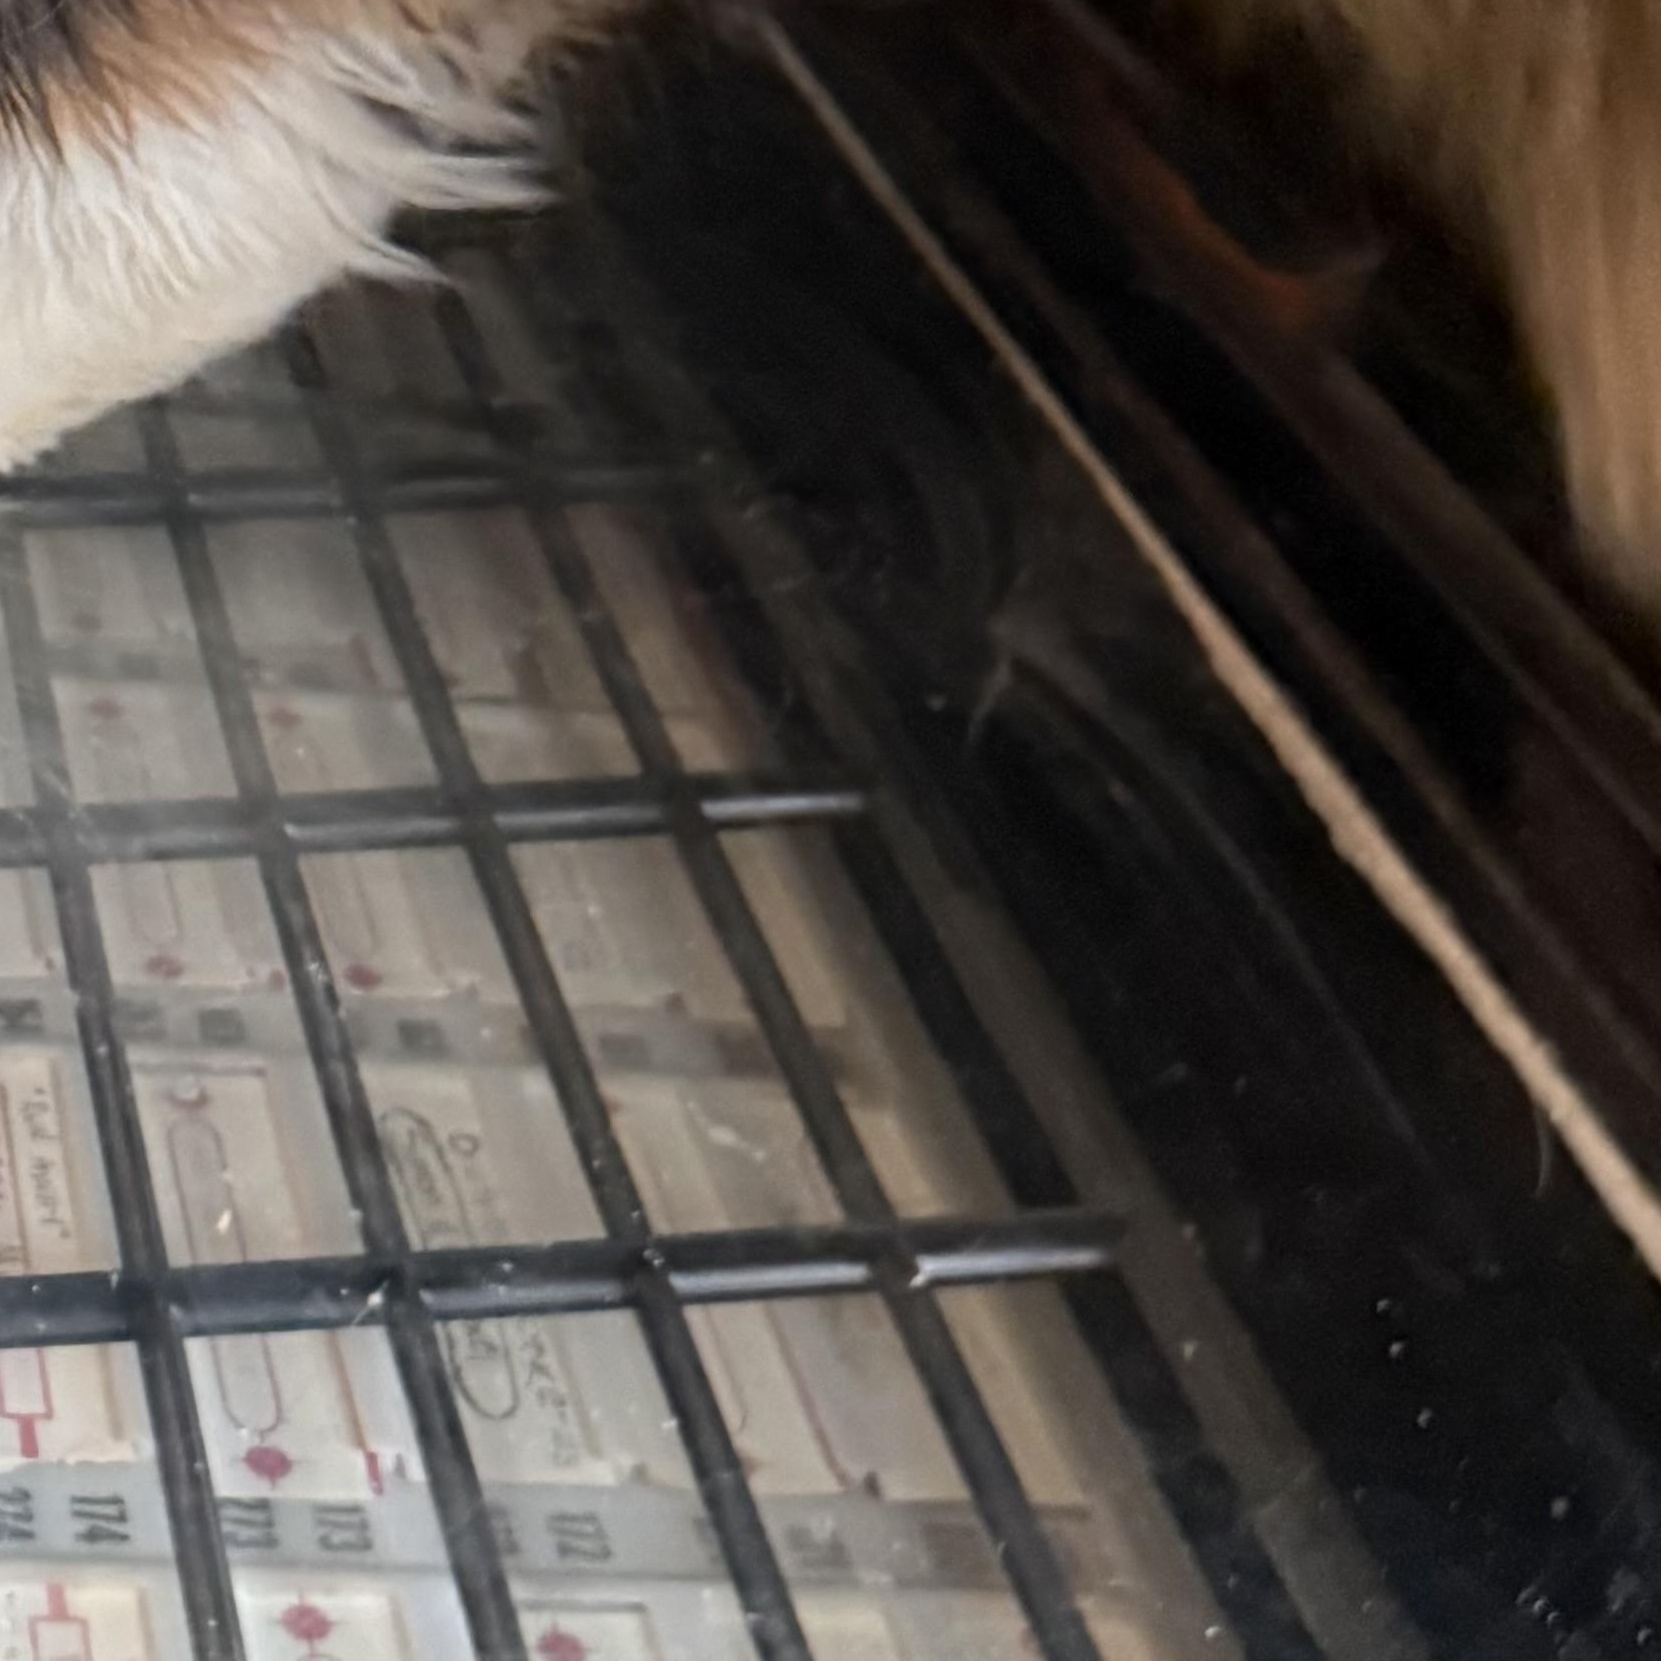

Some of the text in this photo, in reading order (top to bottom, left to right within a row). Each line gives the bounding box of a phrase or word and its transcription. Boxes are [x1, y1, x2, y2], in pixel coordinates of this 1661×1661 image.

[70, 1494, 131, 1542] 174
[312, 1503, 373, 1552] 173
[546, 1509, 613, 1563] 172
